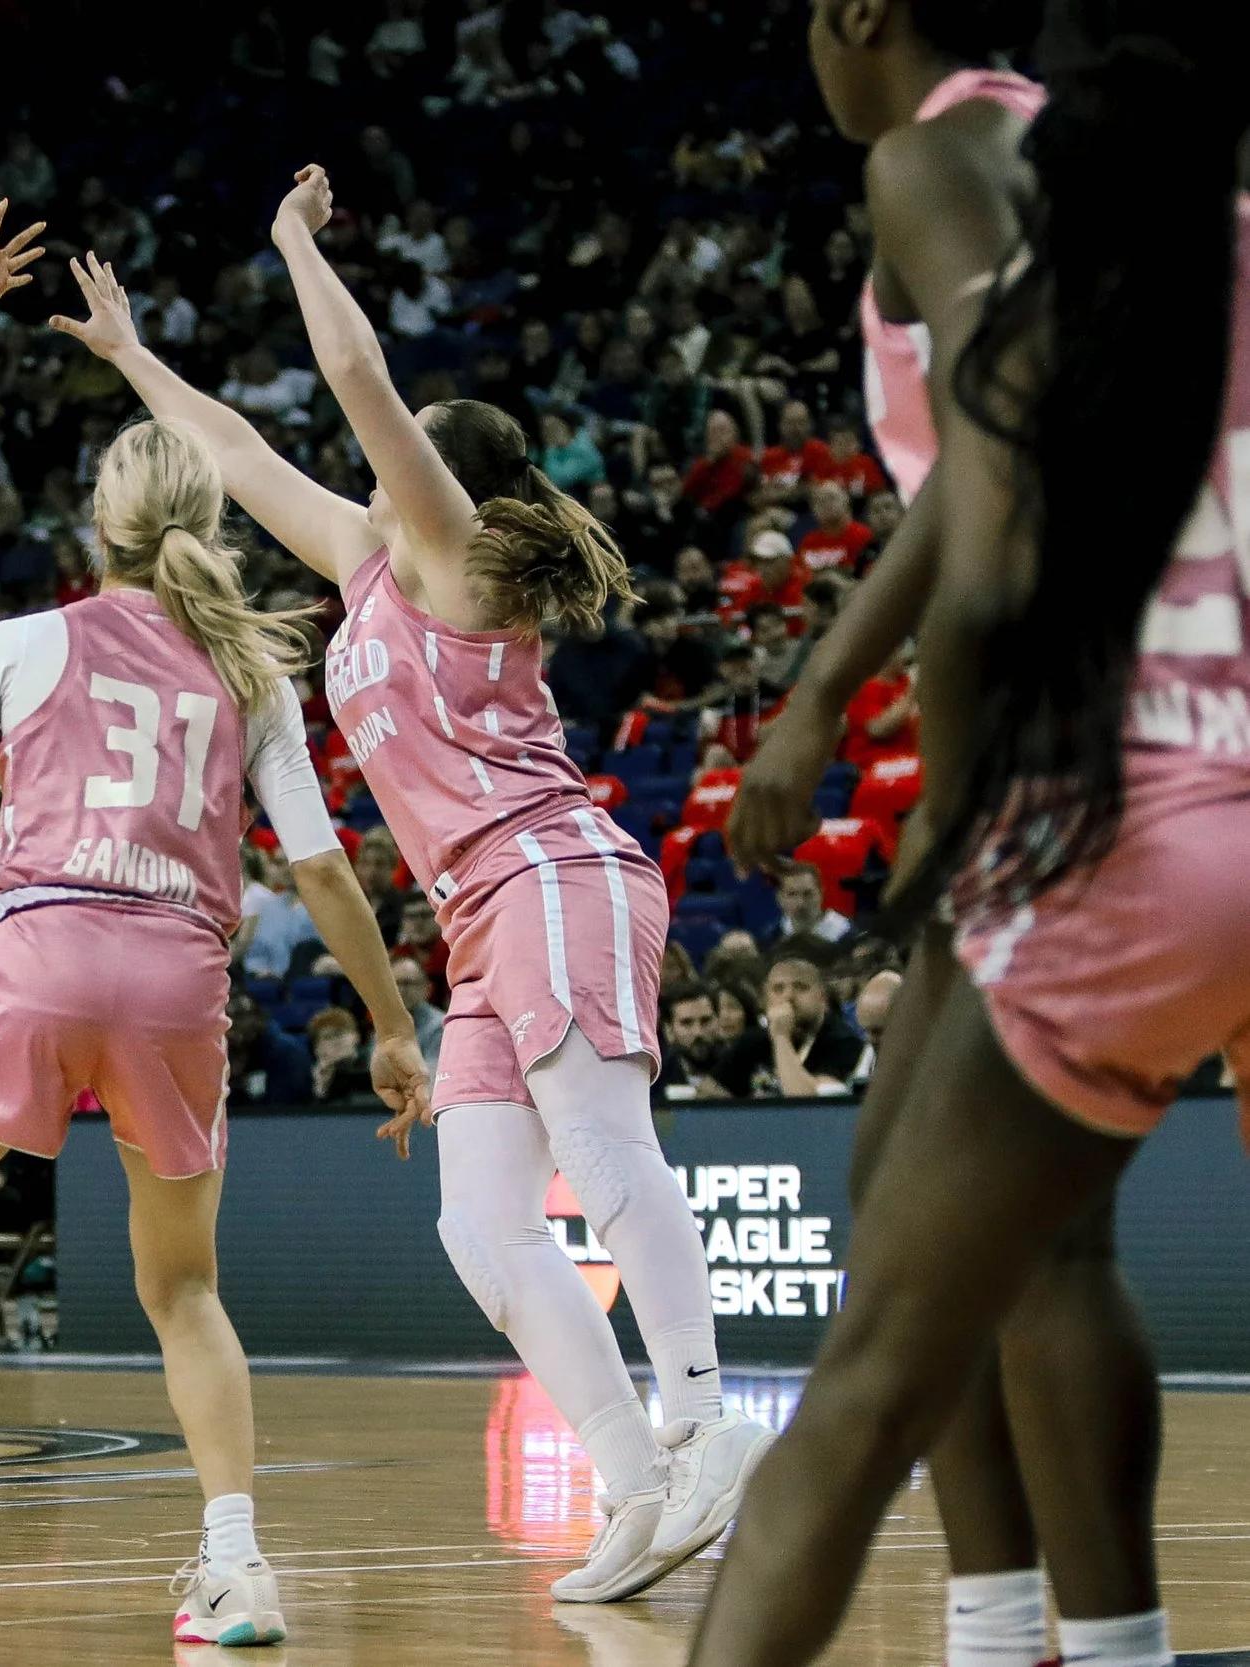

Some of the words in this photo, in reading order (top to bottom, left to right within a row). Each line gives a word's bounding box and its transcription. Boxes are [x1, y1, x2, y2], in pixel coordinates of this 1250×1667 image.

[85, 671, 217, 831] 31
[347, 706, 398, 768] RAUN
[671, 1165, 801, 1212] UPER
[697, 1217, 832, 1264] AGUE
[709, 1268, 848, 1318] SKET
